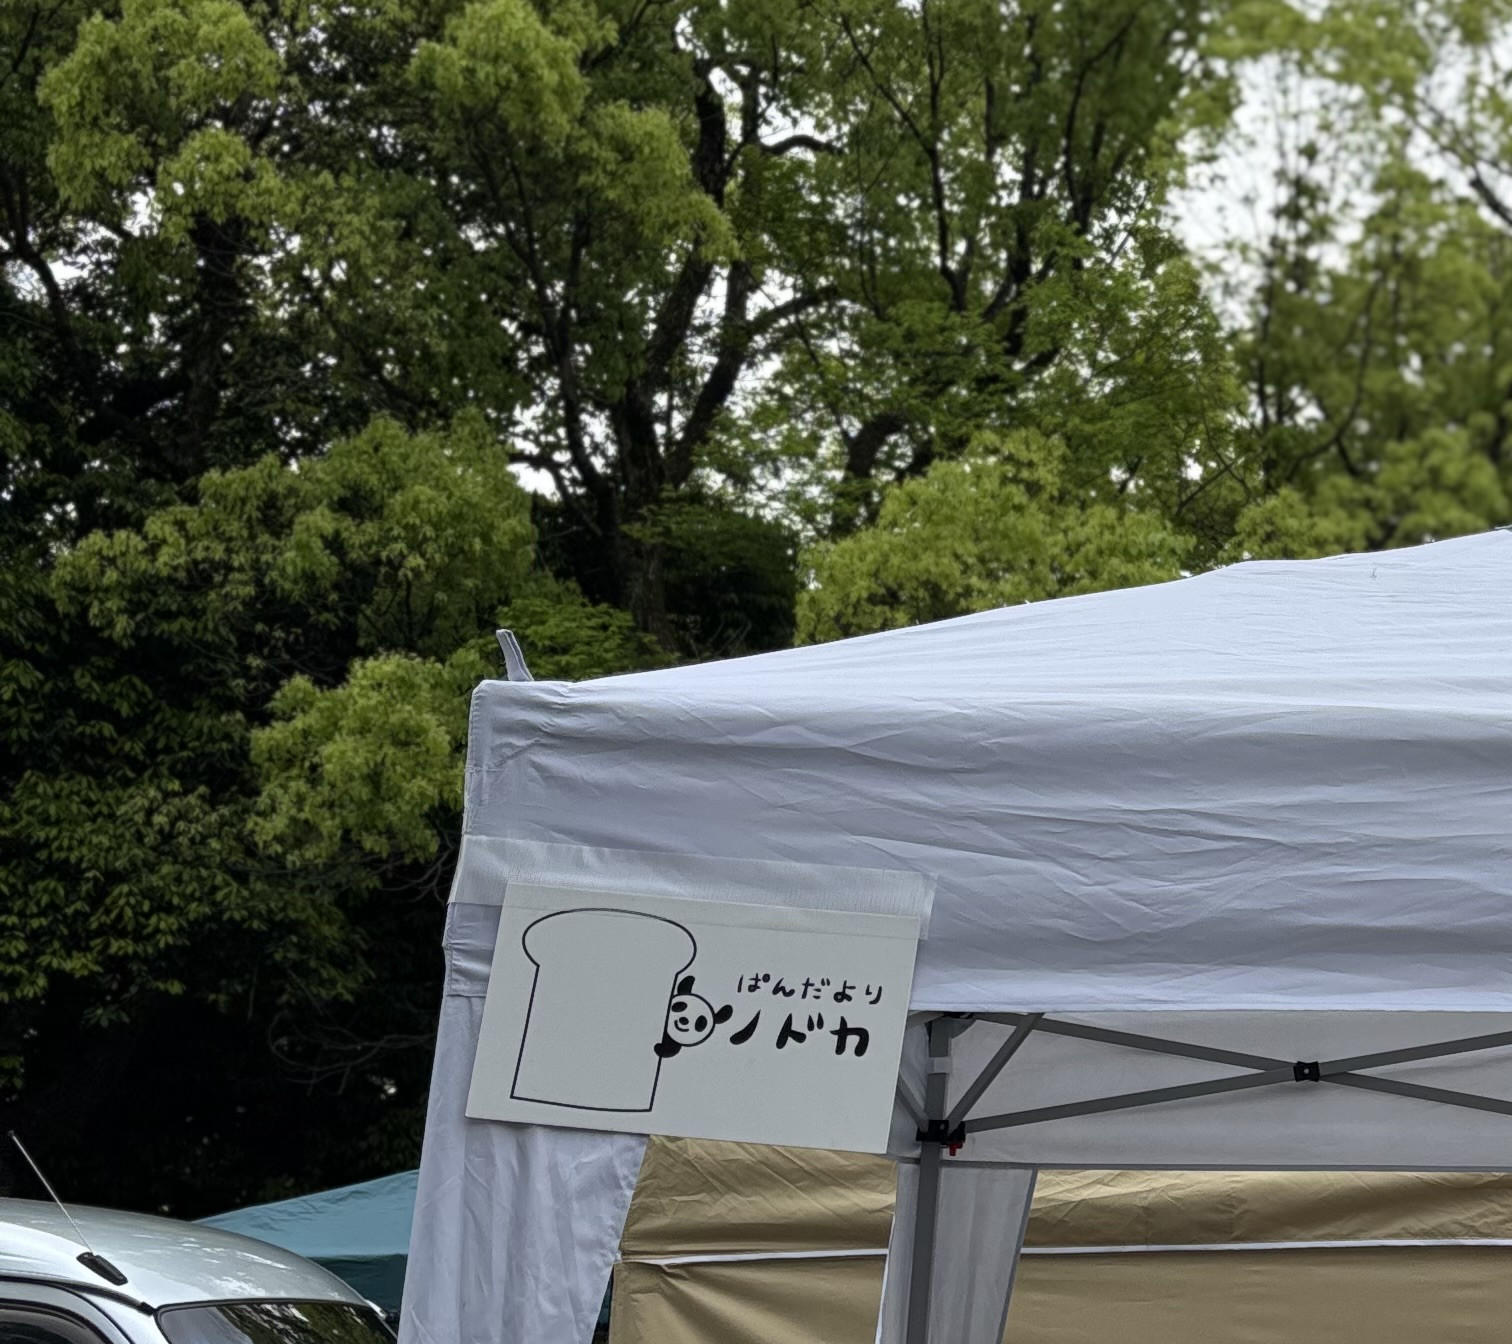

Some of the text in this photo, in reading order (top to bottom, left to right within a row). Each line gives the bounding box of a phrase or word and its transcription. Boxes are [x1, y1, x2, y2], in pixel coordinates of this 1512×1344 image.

[737, 973, 883, 1005] ぱんだより
[729, 1009, 869, 1057] ノドカ
